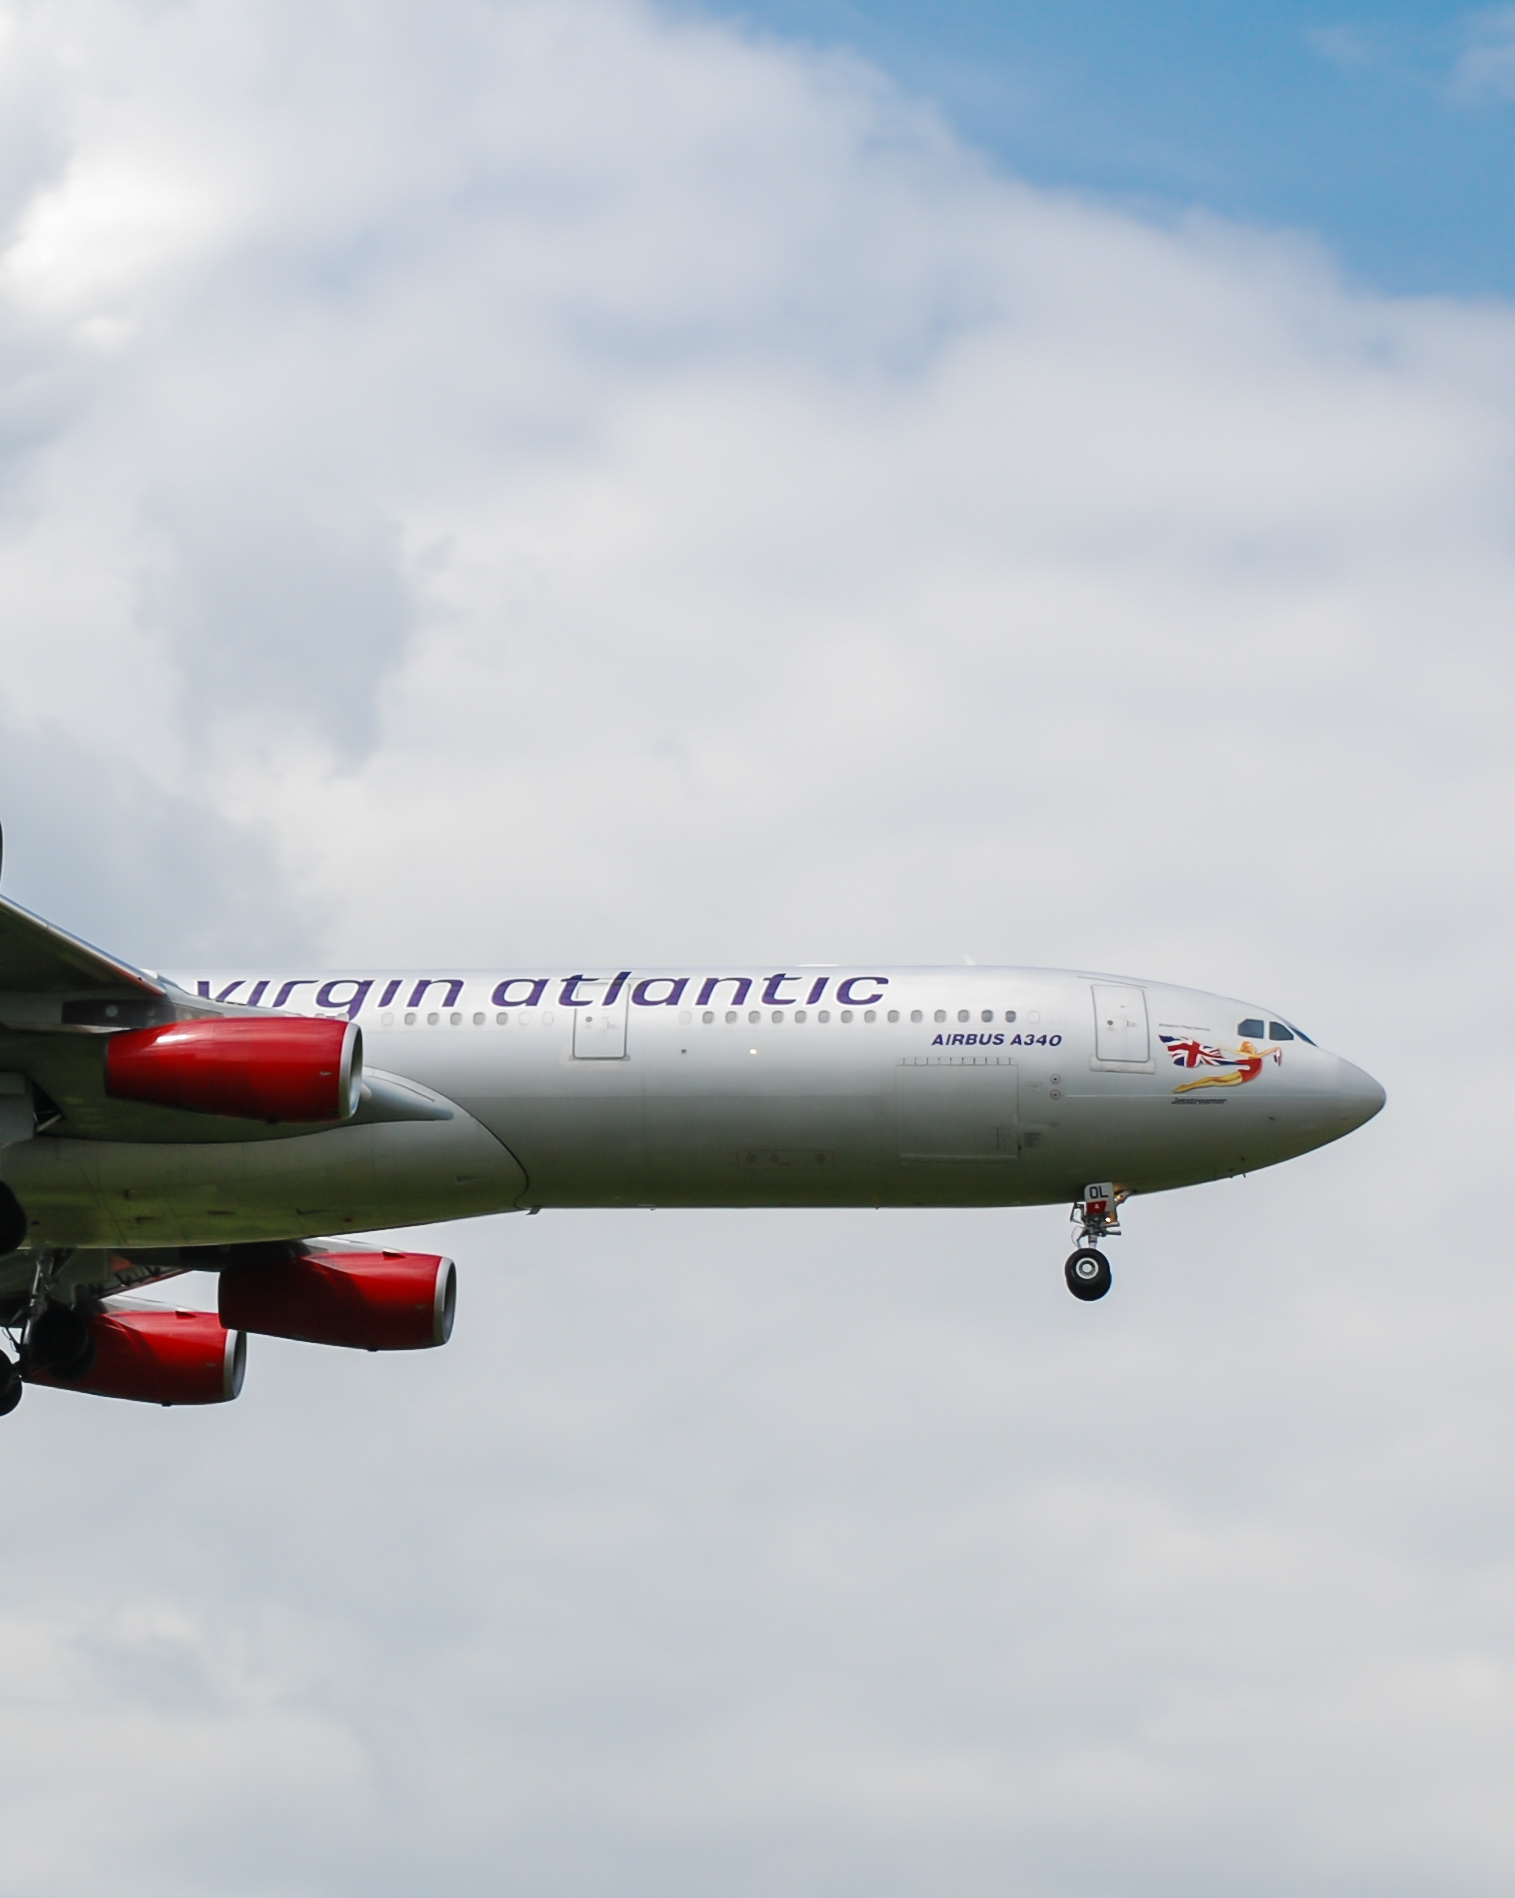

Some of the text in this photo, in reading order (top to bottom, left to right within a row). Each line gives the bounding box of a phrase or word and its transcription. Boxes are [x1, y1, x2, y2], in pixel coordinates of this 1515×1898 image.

[196, 971, 890, 1022] virgin atlantic
[931, 1033, 1063, 1047] AIRBUS A340
[1089, 1185, 1109, 1199] OL
